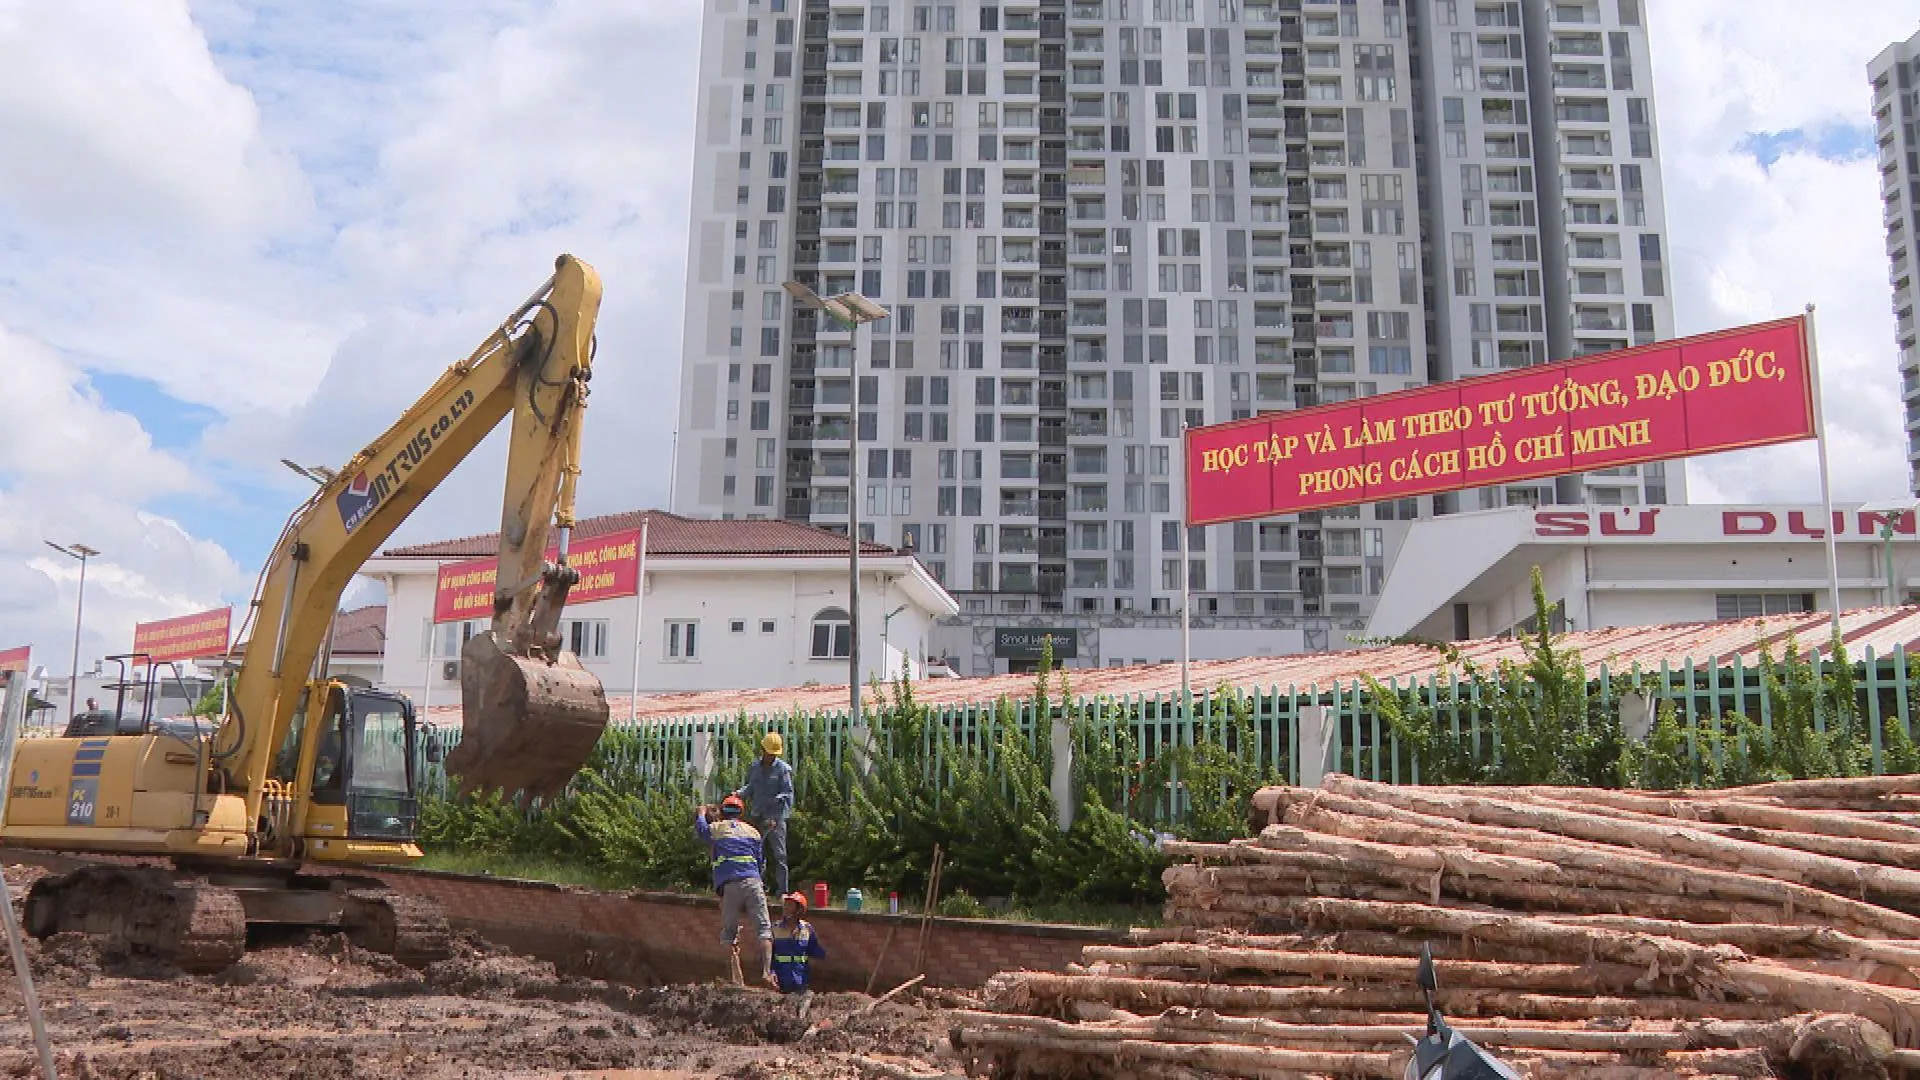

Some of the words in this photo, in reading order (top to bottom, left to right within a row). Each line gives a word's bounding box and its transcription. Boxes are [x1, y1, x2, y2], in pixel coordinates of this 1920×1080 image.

[1202, 444, 1248, 474] HỌC
[1254, 433, 1298, 466] TẬP
[1304, 424, 1336, 454] VÀ
[1343, 417, 1396, 449] LÀM
[1402, 406, 1472, 439] THEO
[1479, 392, 1515, 426] TƯ
[1522, 378, 1628, 419] TƯỞNG,
[1635, 366, 1700, 400] ĐẠO
[1707, 348, 1785, 387] ĐỨC,
[1299, 462, 1383, 496] PHONG
[1389, 450, 1460, 480] CÁCH
[1467, 430, 1506, 470] HỒ
[1514, 425, 1564, 463] CHÍ
[1571, 419, 1652, 455] MINH
[1535, 507, 1661, 537] SỬ
[1001, 634, 1028, 646] Small
[1031, 634, 1071, 646] Wder
[70, 801, 93, 817] 210
